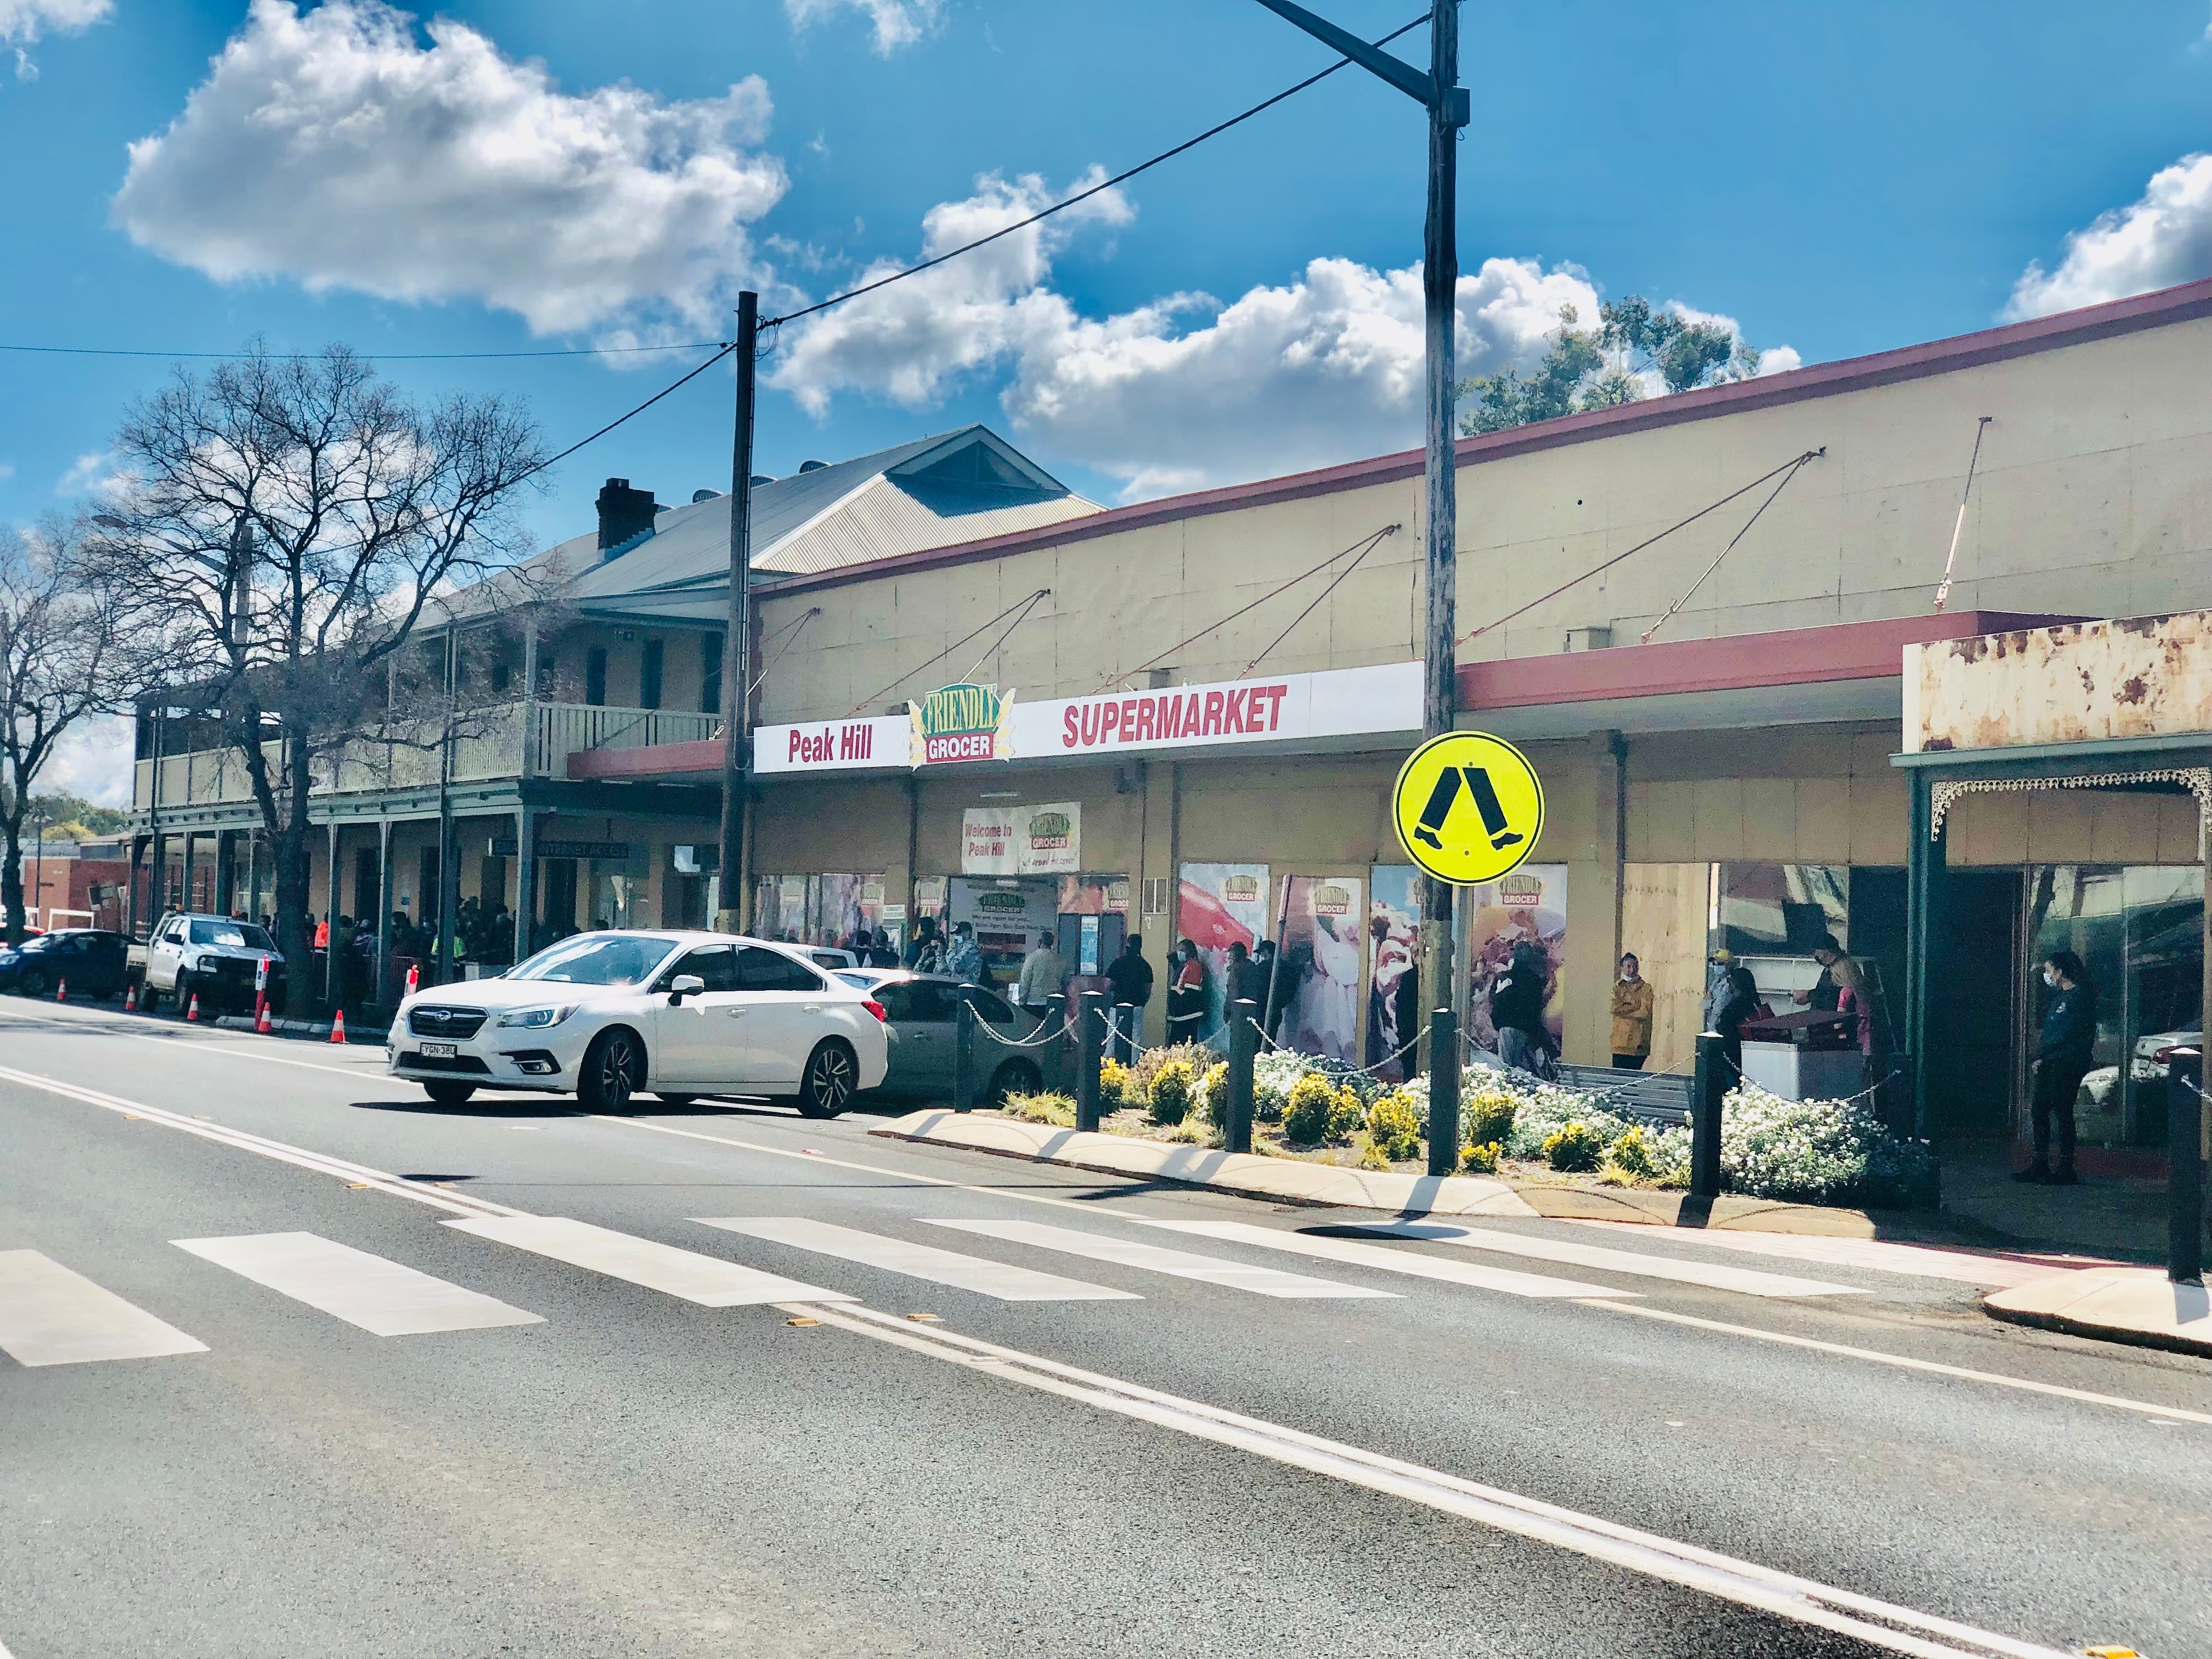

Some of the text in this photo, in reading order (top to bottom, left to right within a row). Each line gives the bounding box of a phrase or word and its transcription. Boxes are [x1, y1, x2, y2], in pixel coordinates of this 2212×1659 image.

[927, 685, 996, 734] FRIENDLY
[1062, 685, 1288, 748] SUPERMARKET
[789, 725, 872, 763] Peak Hill
[929, 735, 990, 759] GROCER
[964, 823, 1012, 838] Welcome to
[969, 842, 1005, 856] Peak Hill
[1032, 837, 1066, 849] GROCER
[1504, 895, 1537, 904] GROCER
[1317, 905, 1345, 913] GROCER
